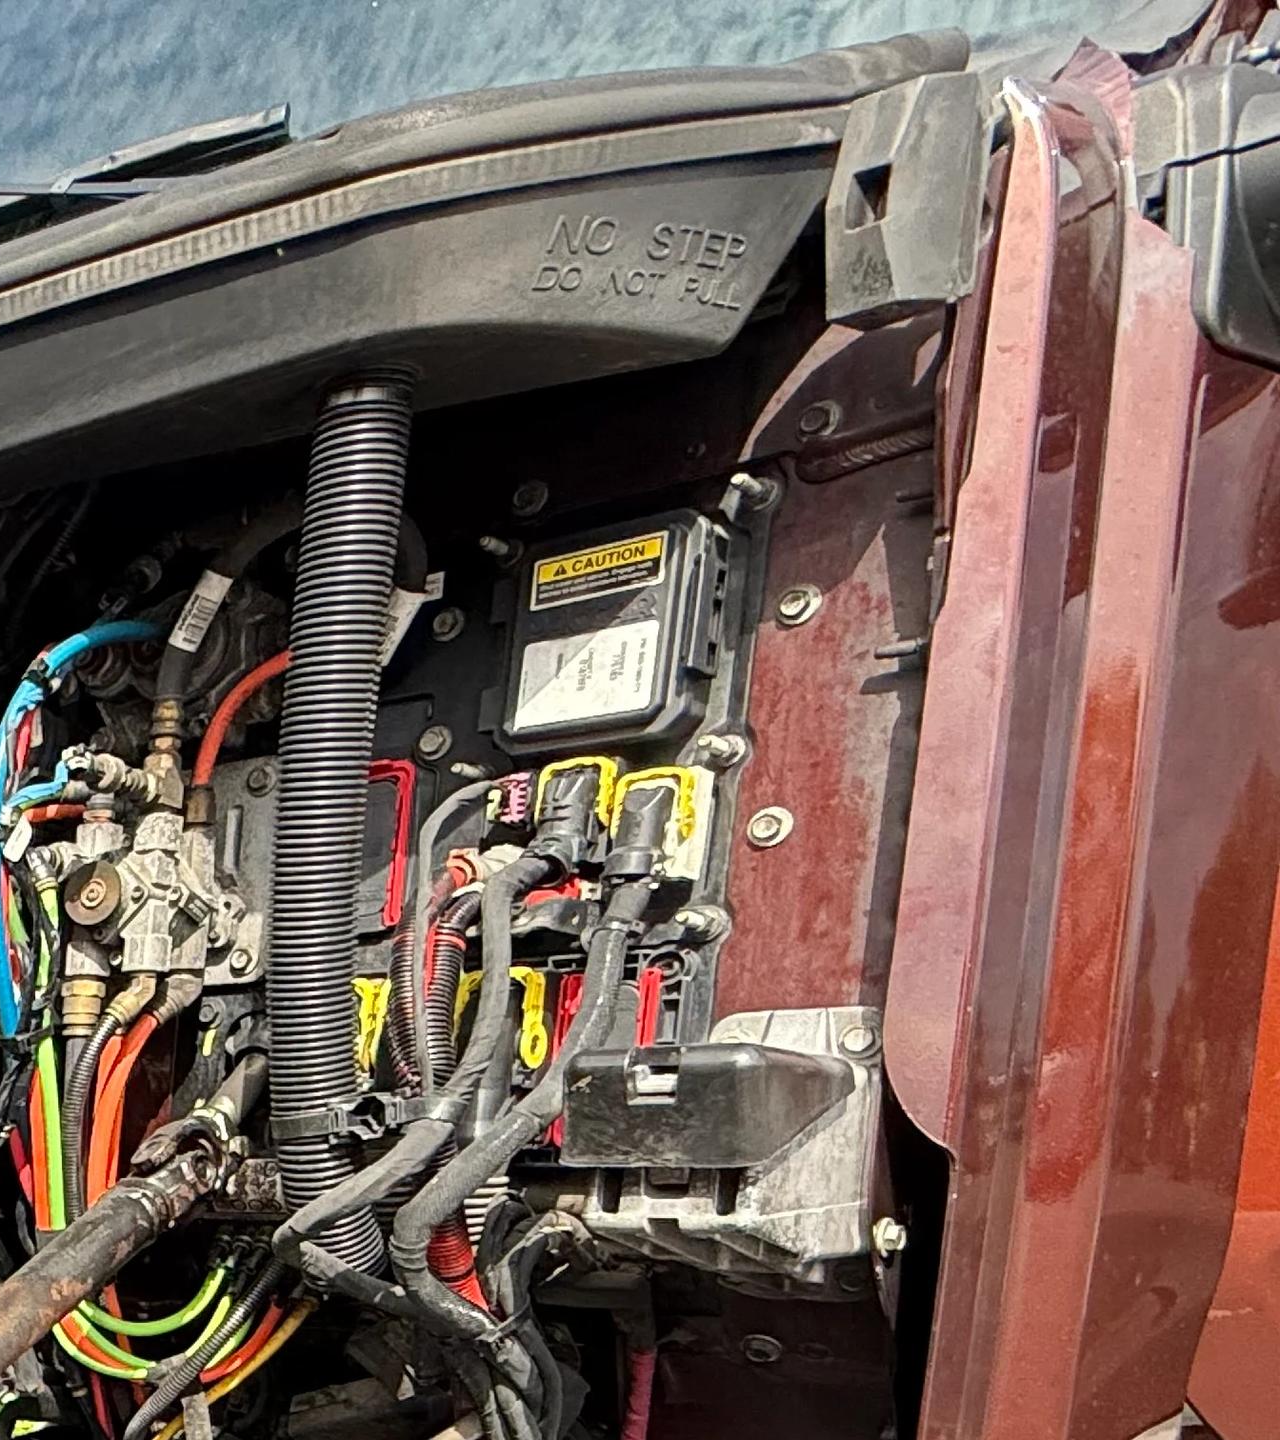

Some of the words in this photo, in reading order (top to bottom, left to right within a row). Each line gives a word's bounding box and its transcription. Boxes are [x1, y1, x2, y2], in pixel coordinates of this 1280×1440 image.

[546, 213, 620, 256] NO
[646, 221, 748, 272] STEP
[531, 265, 584, 293] DO
[599, 268, 667, 299] NOT
[677, 274, 741, 312] PULL
[571, 545, 646, 573] CAUTION
